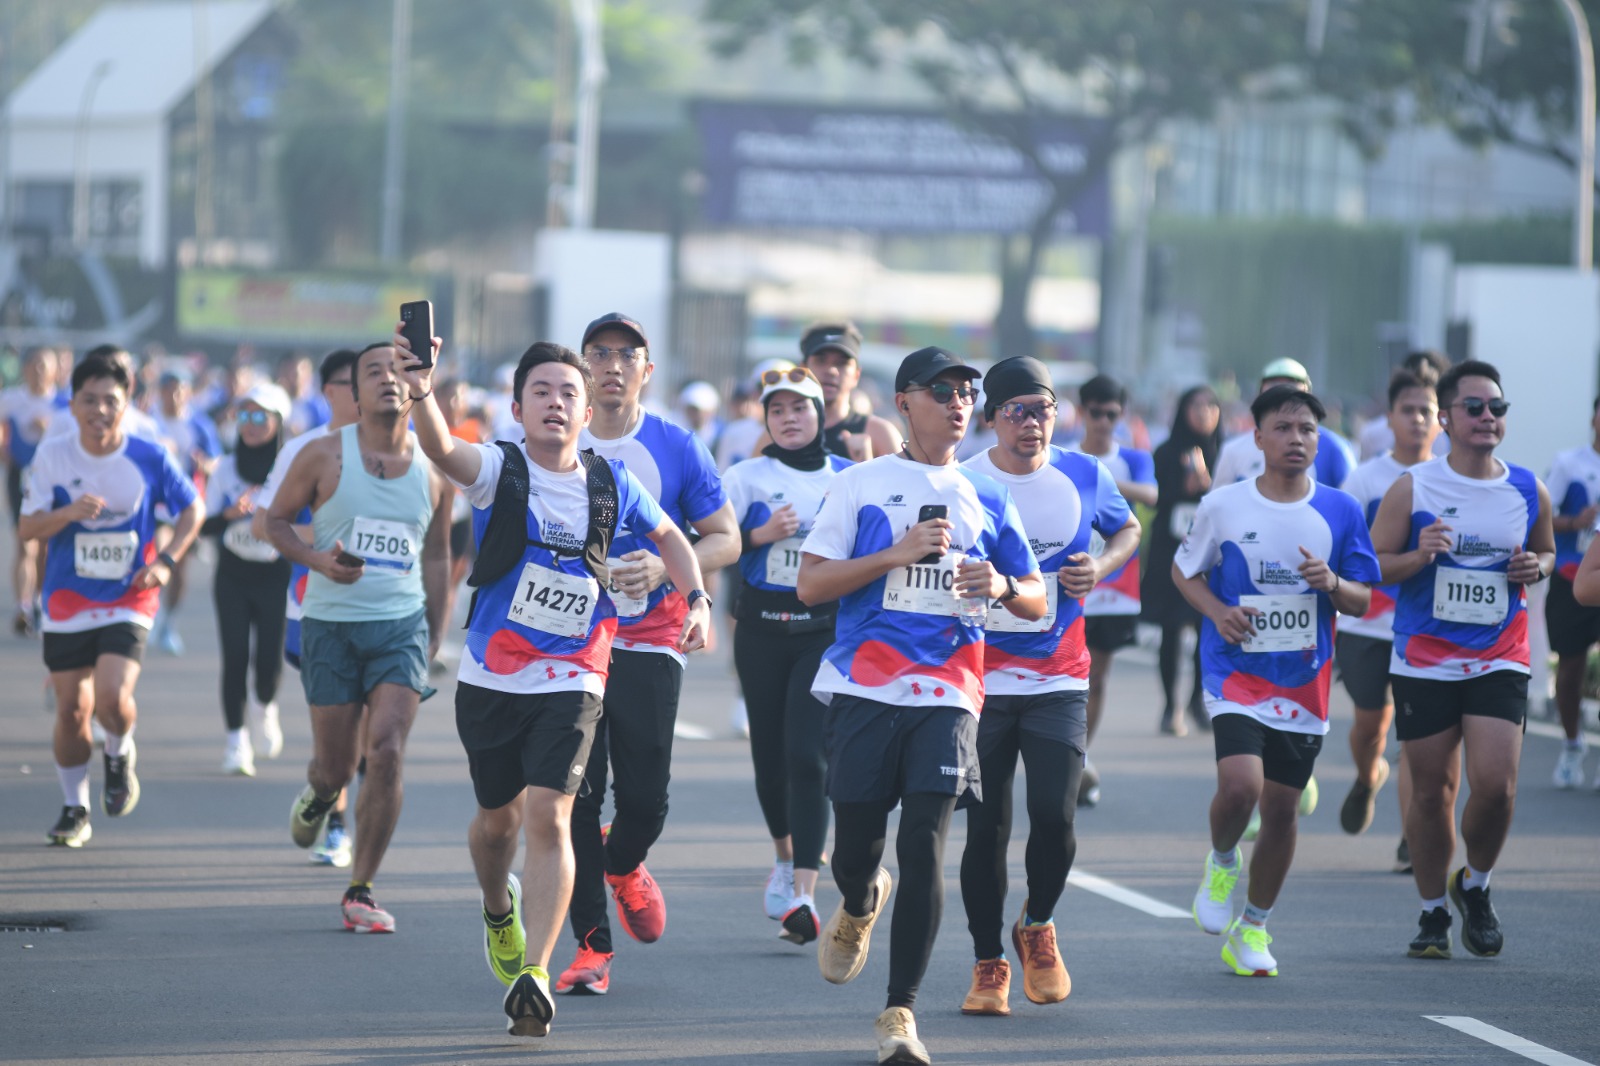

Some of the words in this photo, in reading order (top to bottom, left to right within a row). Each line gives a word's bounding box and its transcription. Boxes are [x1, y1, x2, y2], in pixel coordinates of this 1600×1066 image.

[548, 521, 564, 531] btn
[546, 530, 575, 540] JAKARTA
[357, 532, 410, 557] 17509
[81, 546, 132, 562] 14087
[1266, 560, 1281, 568] btn
[905, 565, 954, 591] 11110
[524, 580, 589, 616] 14273
[887, 592, 899, 602] M
[1448, 582, 1496, 605] 11193
[512, 605, 523, 615] M
[761, 610, 780, 621] Field
[790, 612, 811, 621] Track
